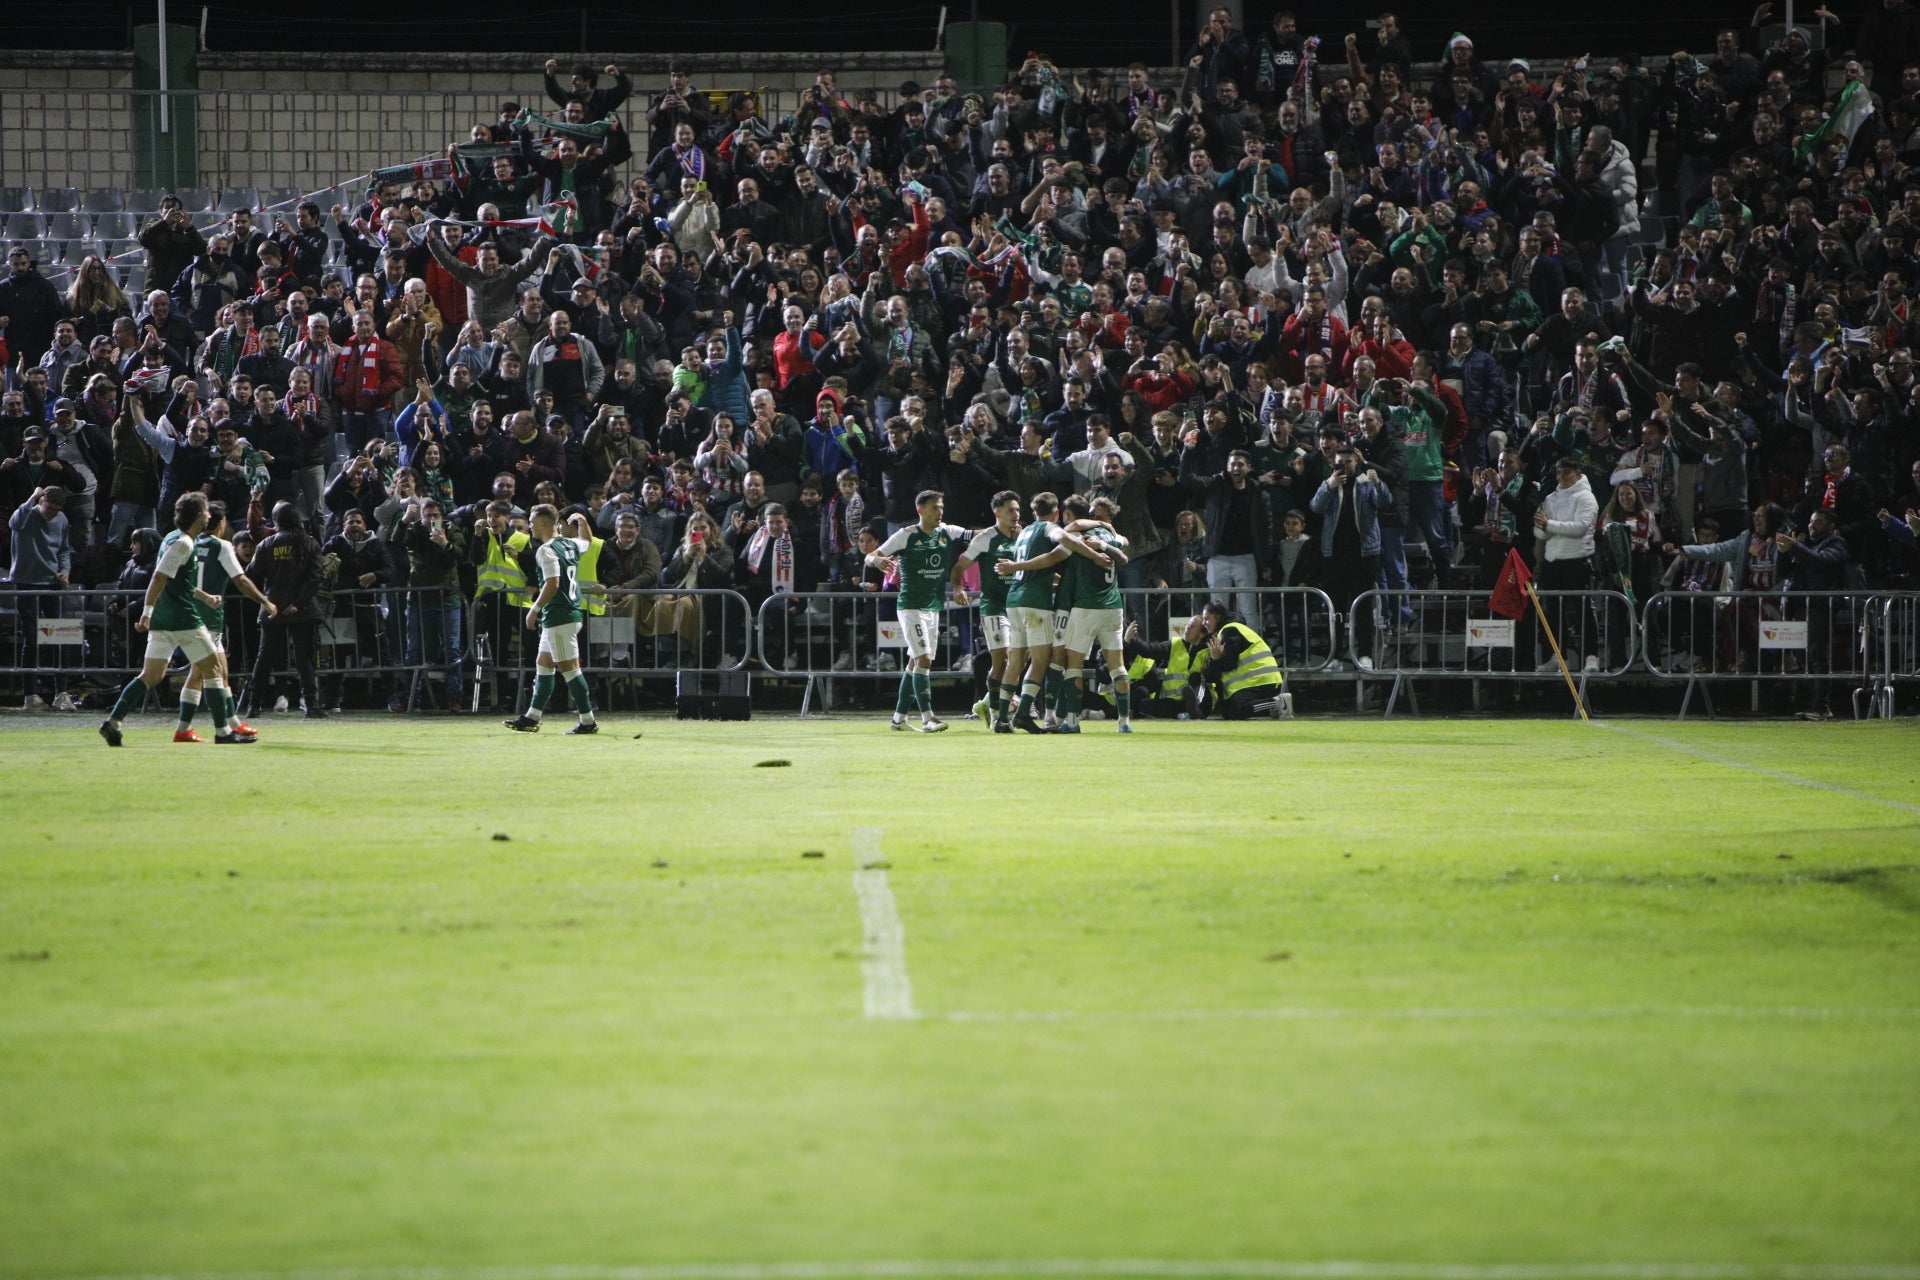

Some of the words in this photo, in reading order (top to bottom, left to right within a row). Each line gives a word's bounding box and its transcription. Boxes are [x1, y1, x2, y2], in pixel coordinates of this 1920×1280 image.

[566, 565, 577, 600] 8
[914, 623, 924, 637] 6
[990, 617, 1001, 632] 11
[1055, 616, 1068, 630] 10
